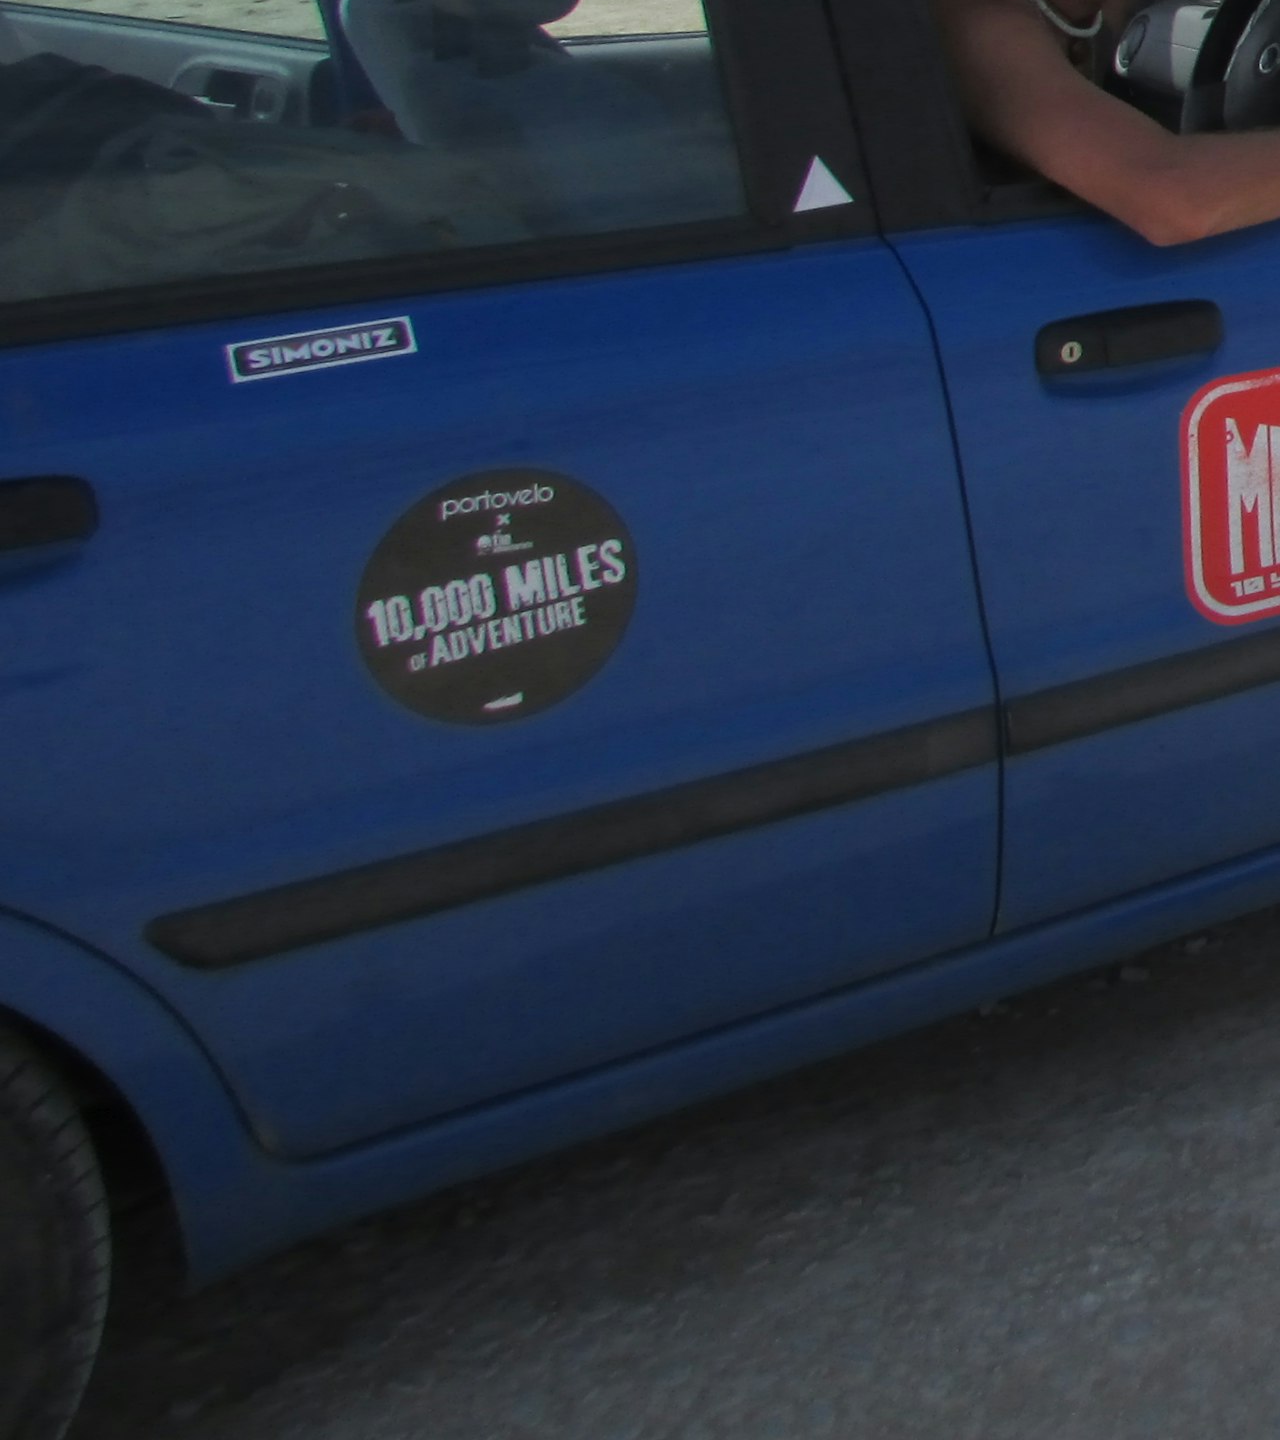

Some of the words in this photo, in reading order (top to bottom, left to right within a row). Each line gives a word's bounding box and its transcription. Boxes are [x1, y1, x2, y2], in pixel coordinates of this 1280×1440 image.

[248, 328, 398, 369] SIMONIZ
[440, 483, 554, 521] portovelo
[367, 573, 497, 647] 10,000
[504, 539, 626, 611] MILES
[1230, 577, 1265, 598] 10
[409, 652, 429, 672] OF
[430, 596, 588, 668] ADVENTURE
